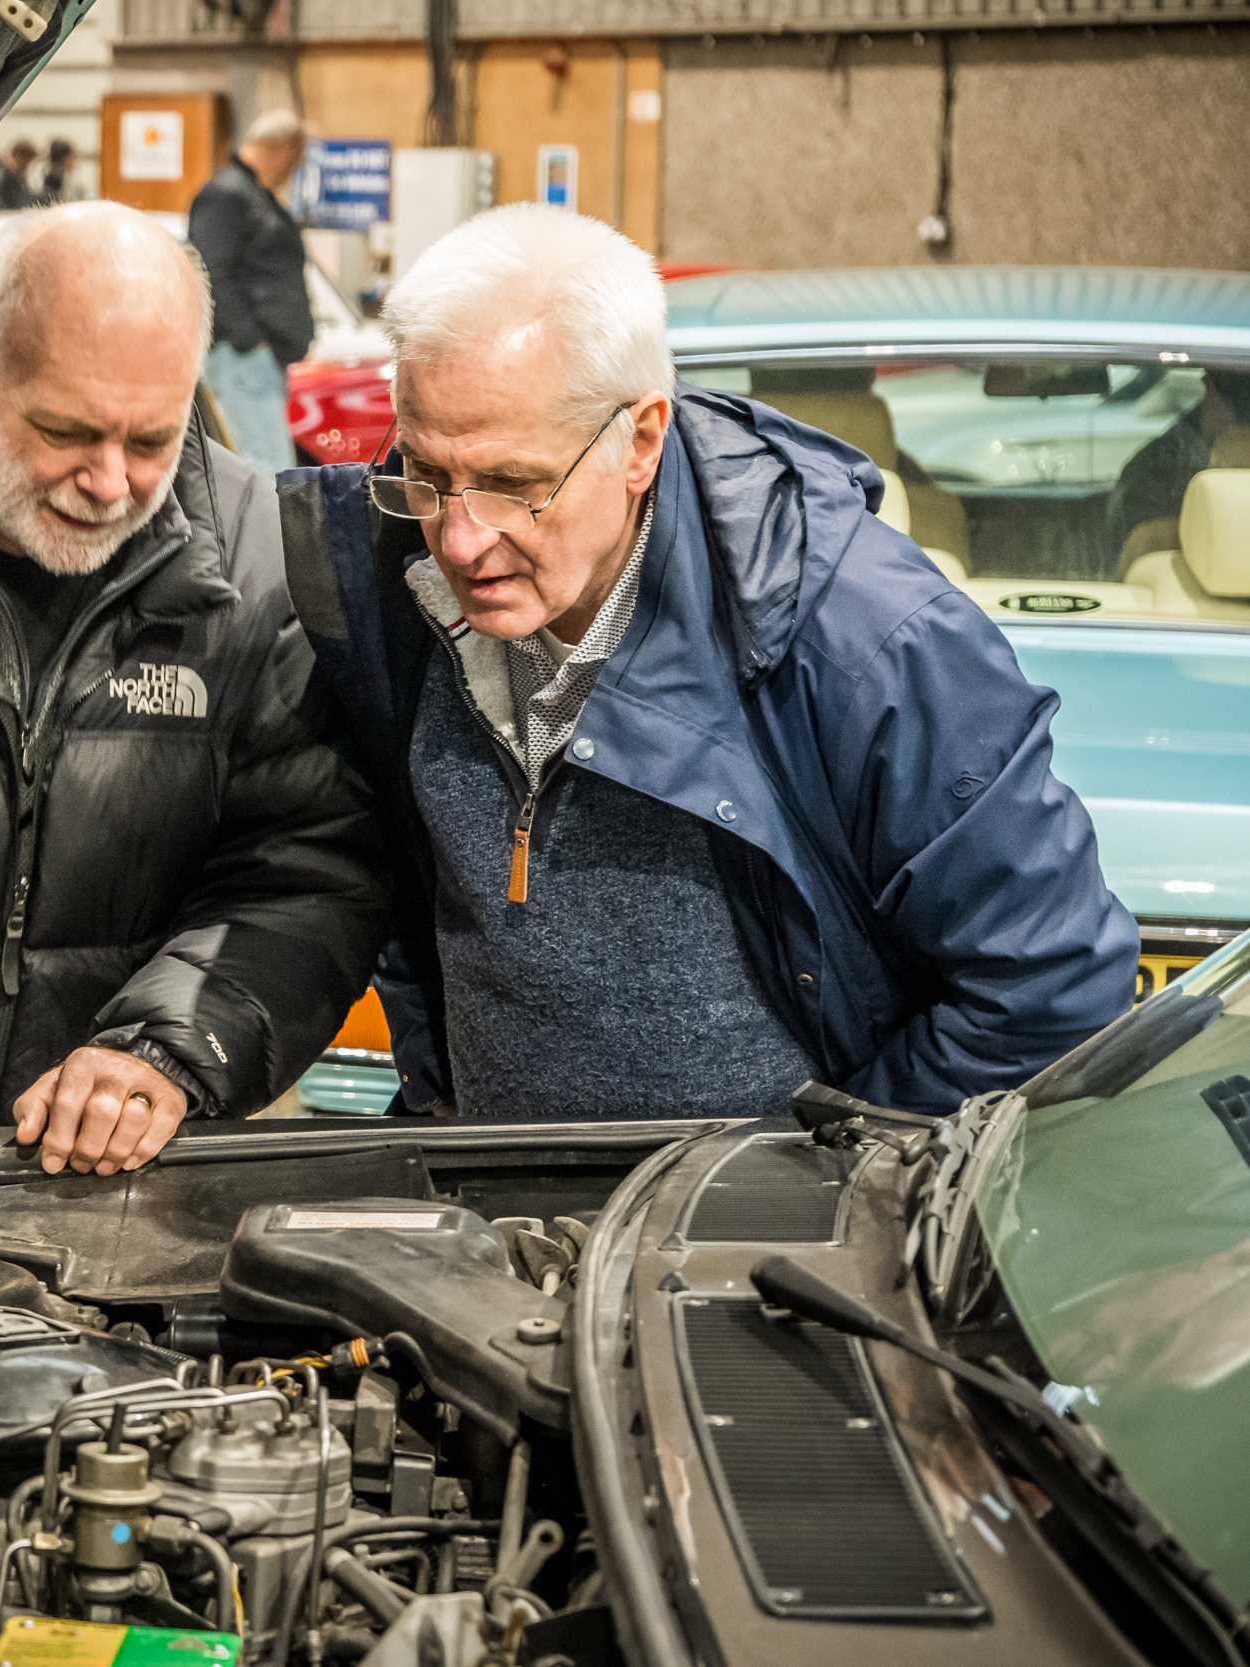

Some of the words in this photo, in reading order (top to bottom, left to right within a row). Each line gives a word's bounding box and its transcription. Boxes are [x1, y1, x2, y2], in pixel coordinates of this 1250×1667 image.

[140, 663, 178, 683] THE
[109, 678, 176, 700] NORTH
[127, 695, 174, 716] FACE
[206, 1032, 228, 1064] 700
